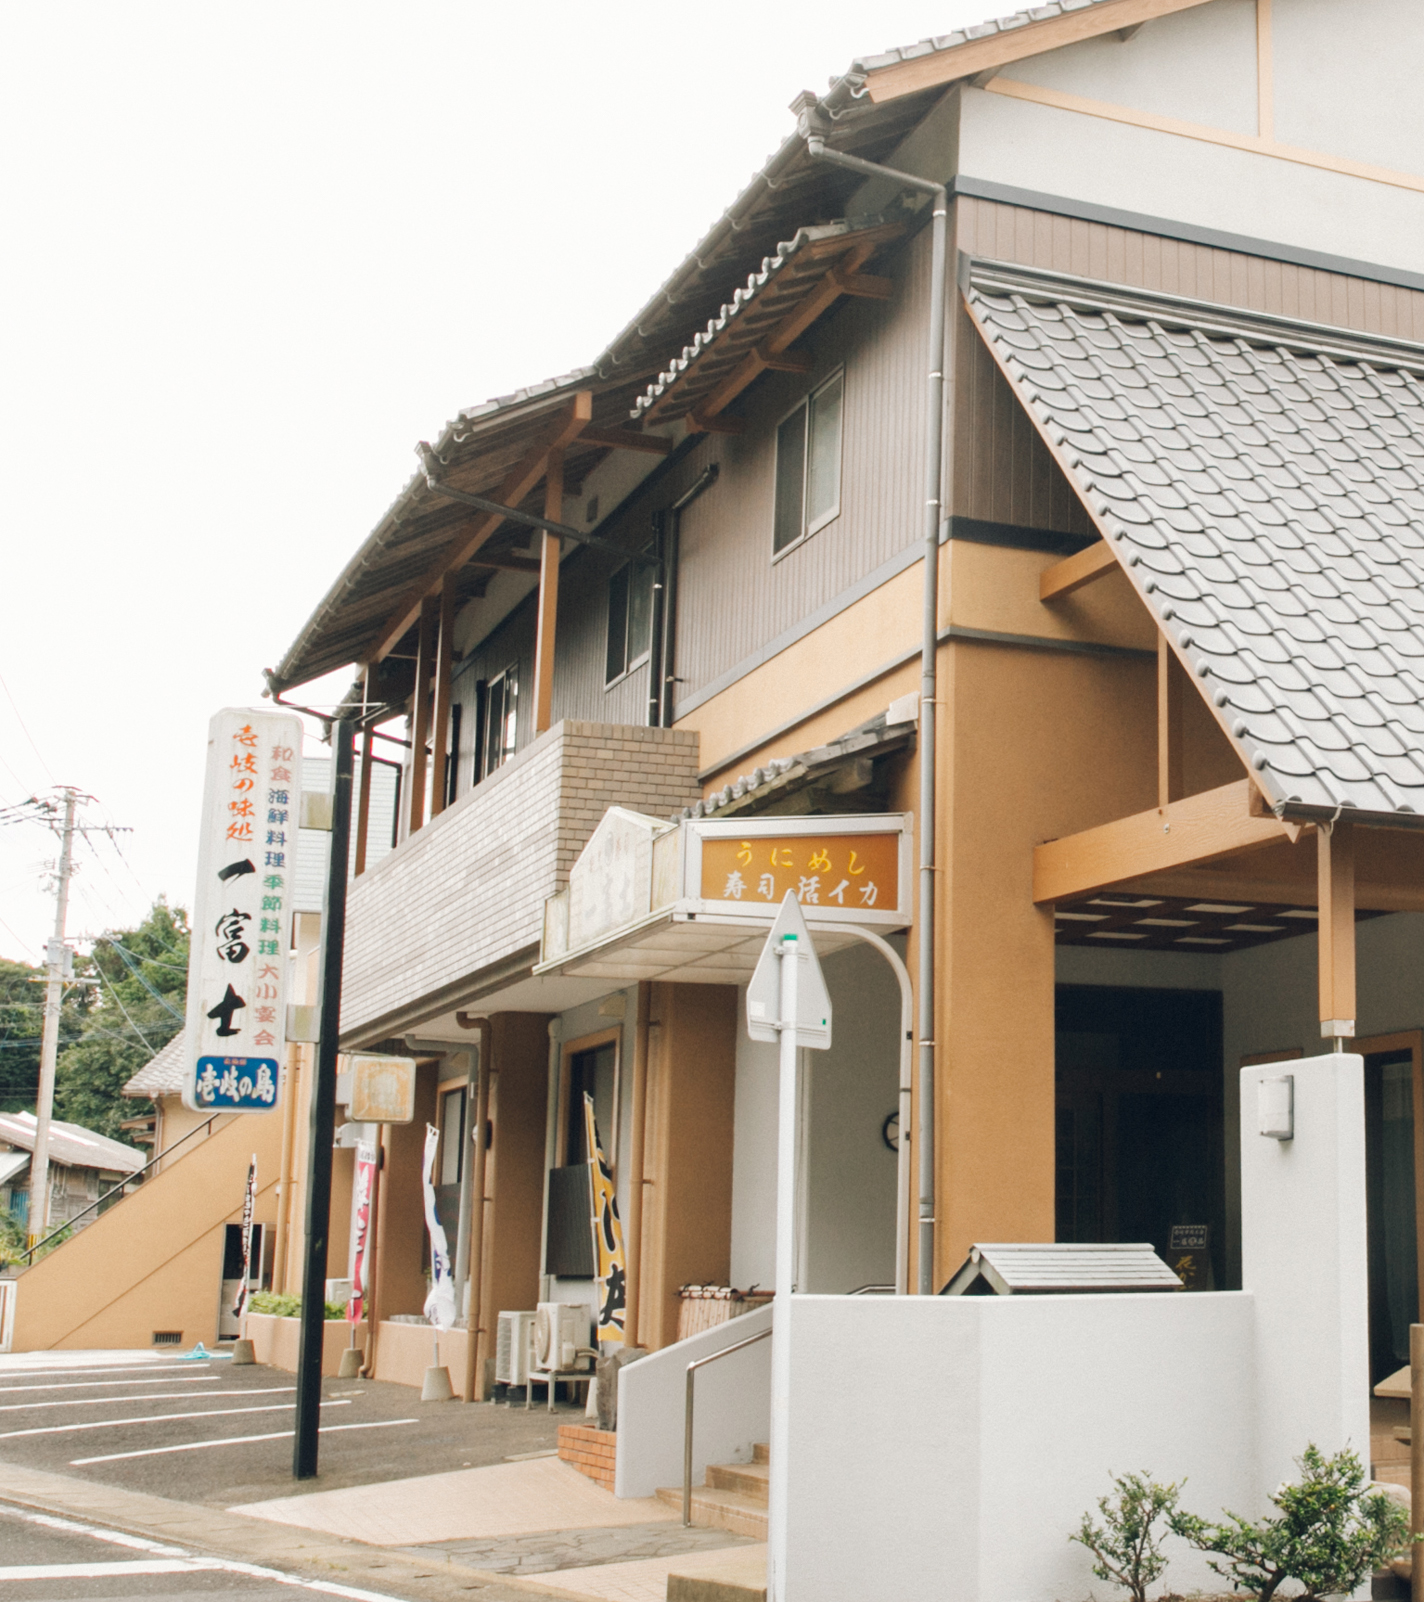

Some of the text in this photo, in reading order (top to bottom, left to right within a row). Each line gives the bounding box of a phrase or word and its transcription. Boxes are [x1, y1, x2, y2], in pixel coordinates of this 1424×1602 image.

[225, 723, 259, 843] 壱岐の味処
[736, 841, 866, 876] うにめし
[207, 857, 257, 1037] 一富士
[196, 1063, 275, 1103] 壱岐の島
